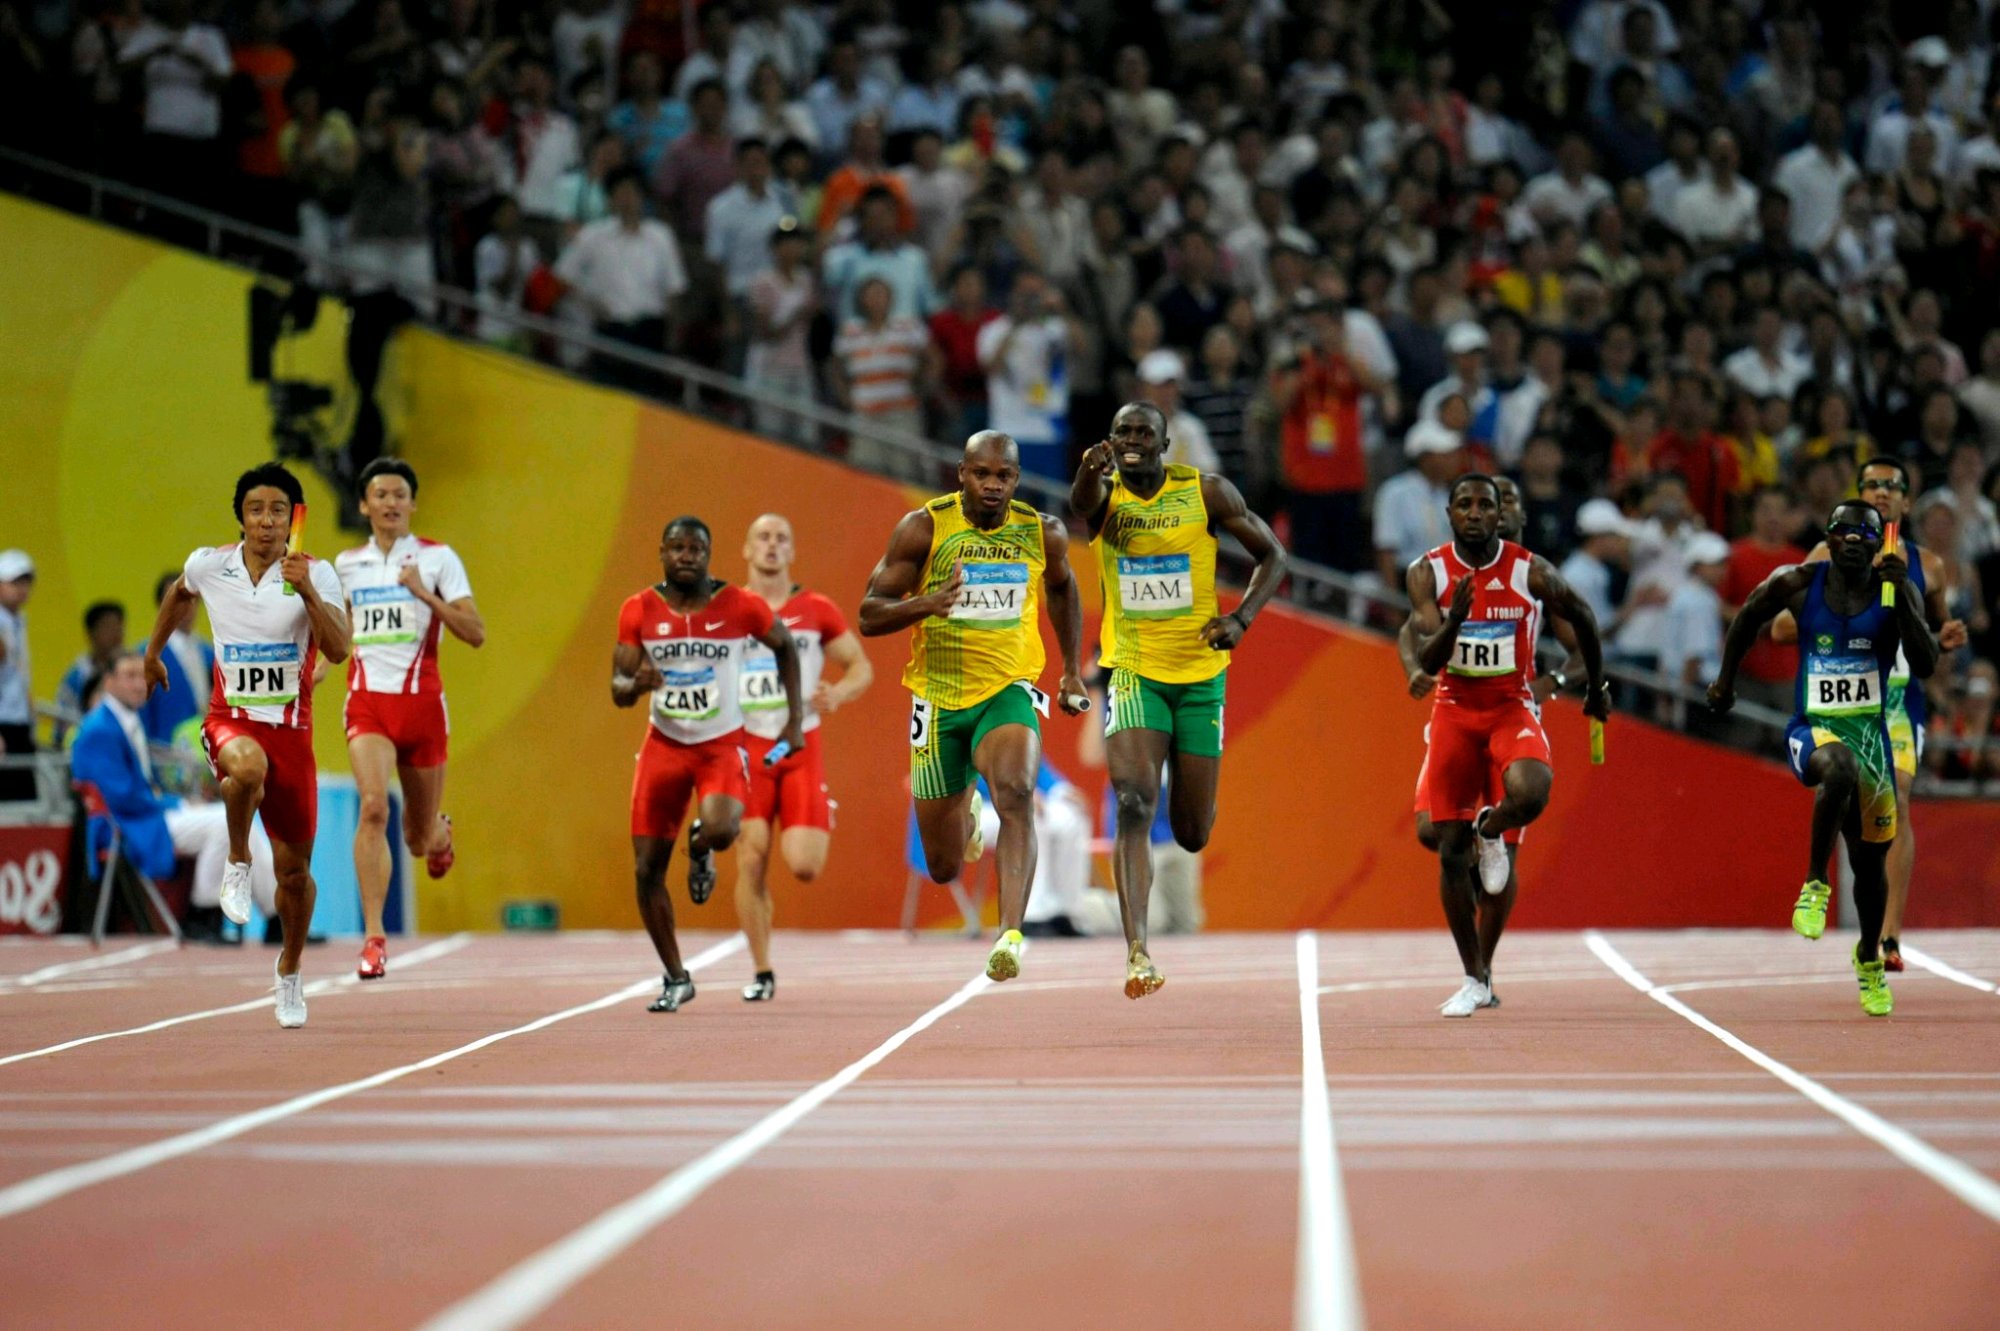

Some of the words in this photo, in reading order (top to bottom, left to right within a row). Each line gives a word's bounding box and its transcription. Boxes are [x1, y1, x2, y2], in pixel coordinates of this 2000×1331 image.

[1118, 512, 1180, 530] jamaica
[954, 541, 1022, 560] jamaica
[961, 589, 1016, 609] JAM
[1131, 579, 1181, 601] JAM
[363, 607, 402, 632] JPN
[1493, 606, 1524, 619] TOBAGO
[652, 642, 730, 660] CANADA
[1458, 642, 1499, 666] TRI
[237, 667, 284, 692] JPN
[664, 688, 708, 711] CAN
[1820, 679, 1870, 703] BRA
[912, 703, 925, 740] 5
